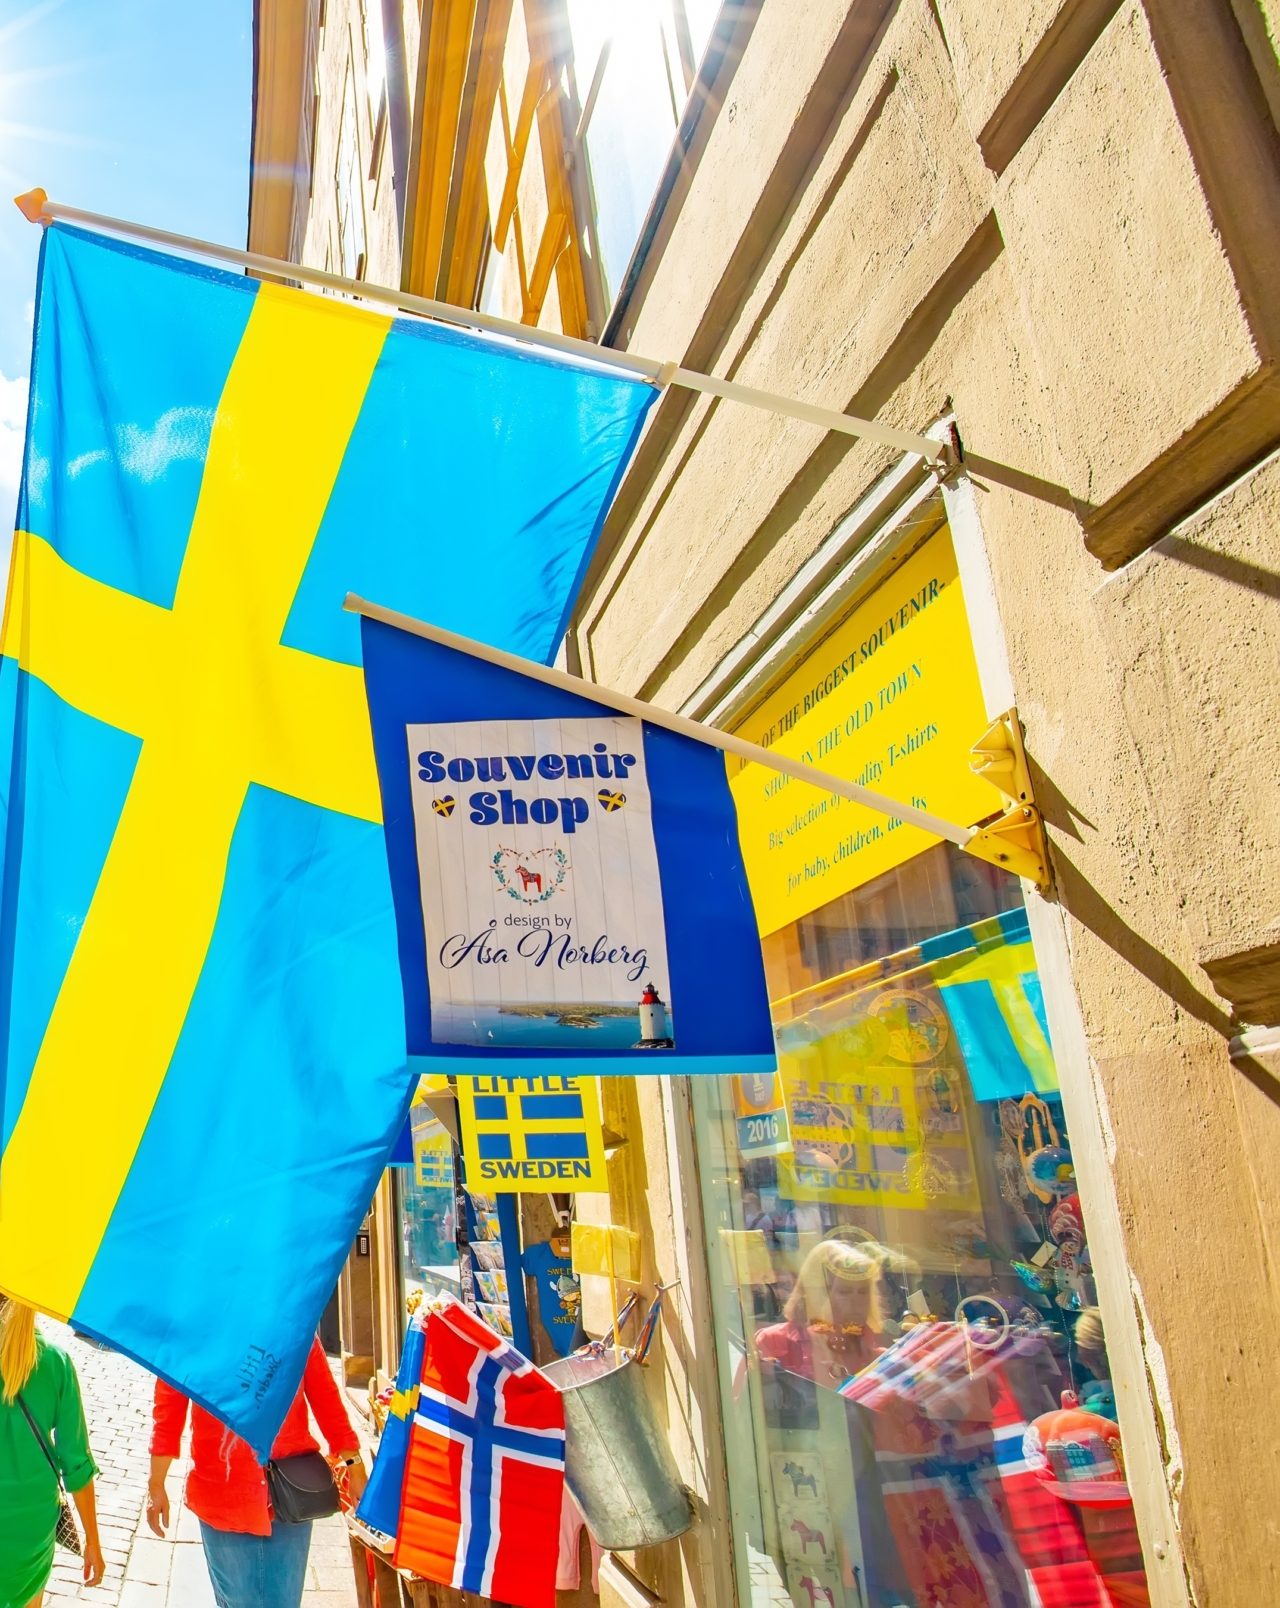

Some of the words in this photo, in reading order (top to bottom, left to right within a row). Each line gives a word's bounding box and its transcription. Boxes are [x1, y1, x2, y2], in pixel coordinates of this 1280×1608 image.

[778, 703, 801, 737] THE
[803, 651, 857, 715] BIGGEST
[860, 578, 945, 664] SOUVENIR-
[817, 725, 842, 759] THE
[846, 701, 874, 737] OLD
[877, 658, 922, 711] TOWN
[417, 743, 637, 783] Souvenir
[769, 830, 784, 850] Big
[786, 801, 827, 837] selection
[888, 722, 938, 768] T-shirts
[468, 789, 590, 834] Shop
[787, 872, 802, 897] for
[804, 856, 830, 881] baby,
[833, 825, 884, 864] children,
[503, 913, 550, 930] design
[554, 914, 572, 930] by
[440, 919, 509, 969] Åsa
[517, 928, 650, 982] Norberg
[472, 1076, 580, 1093] LITTLE
[747, 1115, 779, 1143] 2016
[480, 1160, 592, 1179] SWEDEN
